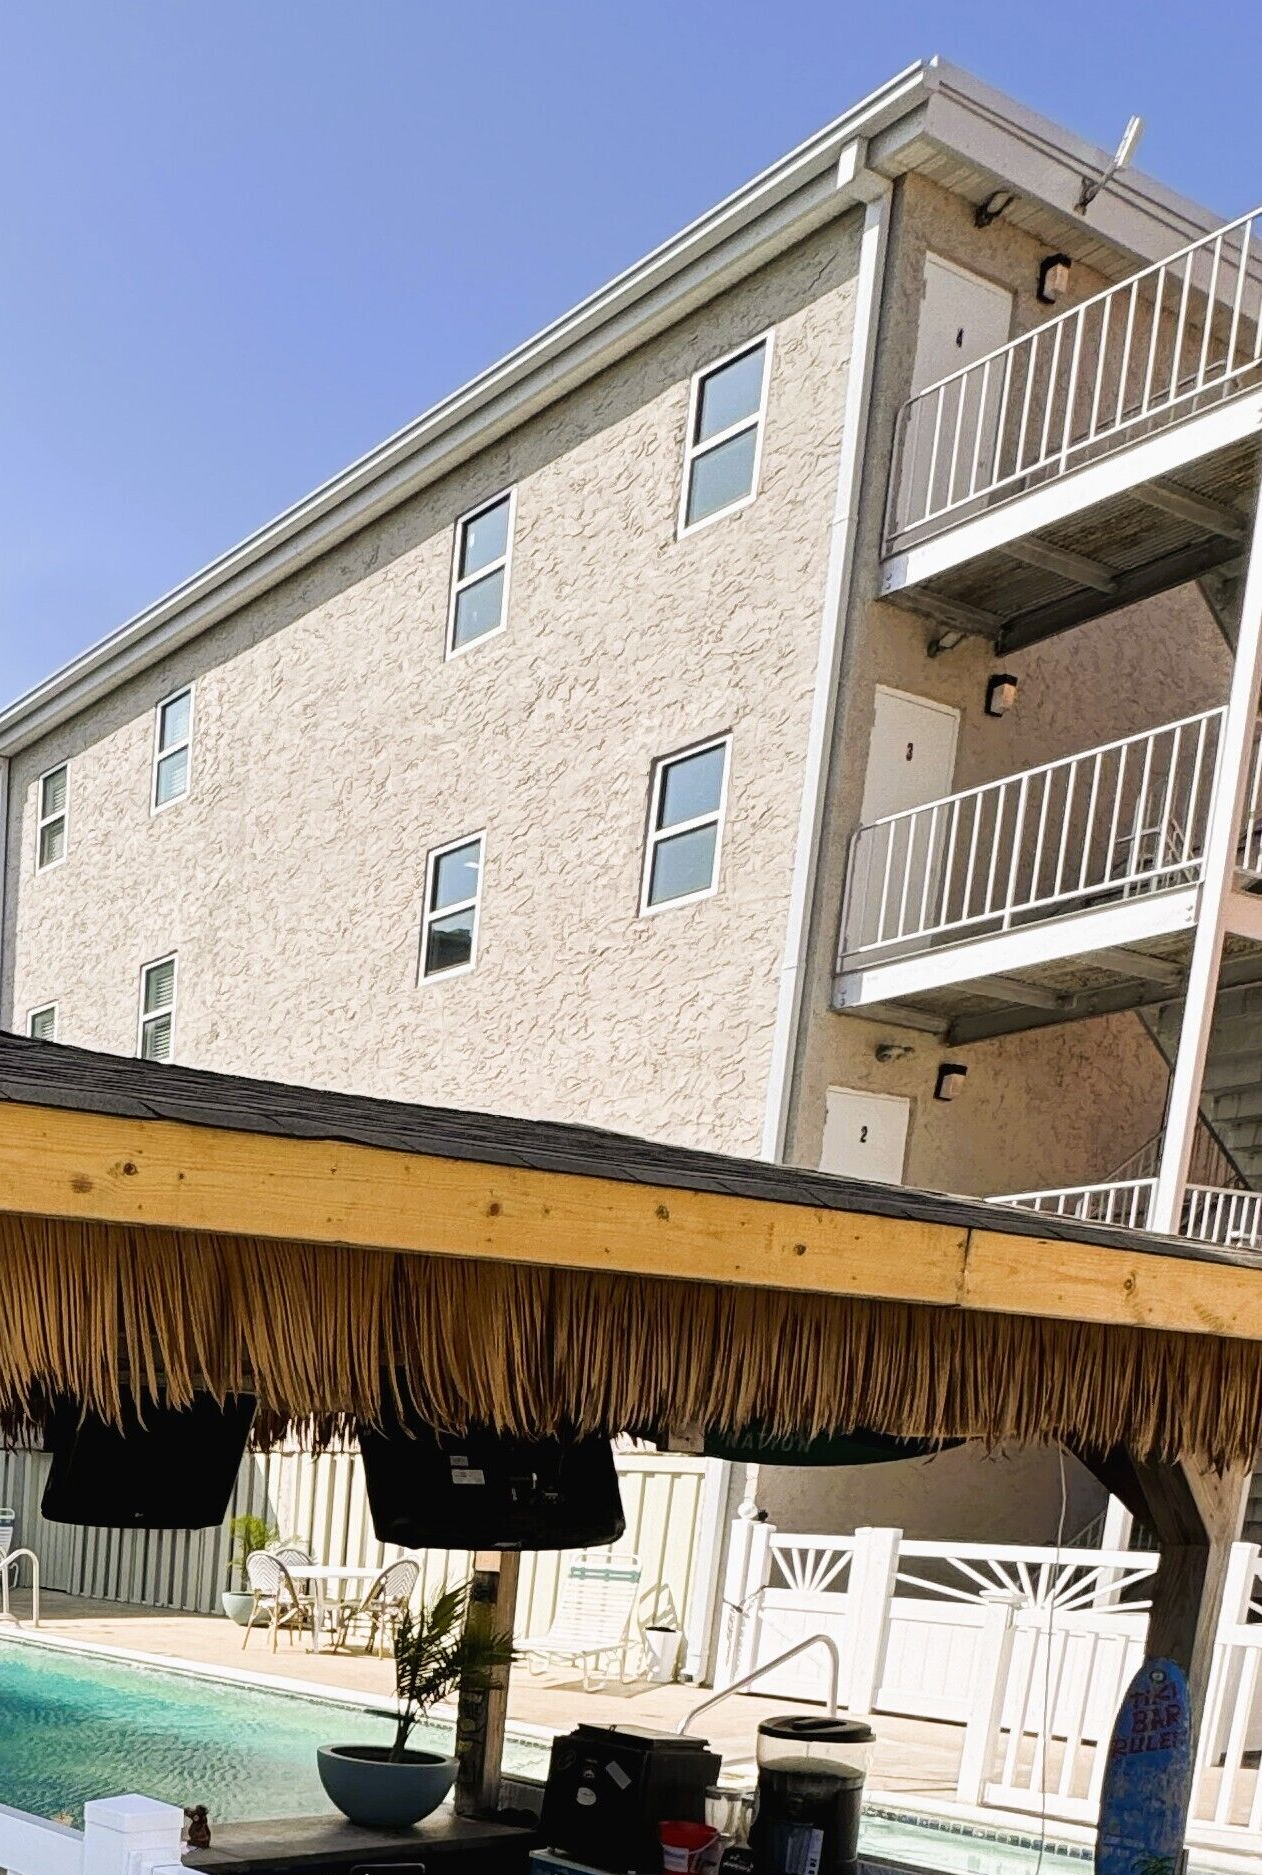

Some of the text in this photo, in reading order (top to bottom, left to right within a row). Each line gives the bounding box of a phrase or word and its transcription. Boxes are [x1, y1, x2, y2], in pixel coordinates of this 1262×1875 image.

[906, 742, 914, 762] 3
[859, 1125, 868, 1143] 2
[1129, 1682, 1177, 1707] TIKI
[1132, 1704, 1181, 1733] BAR
